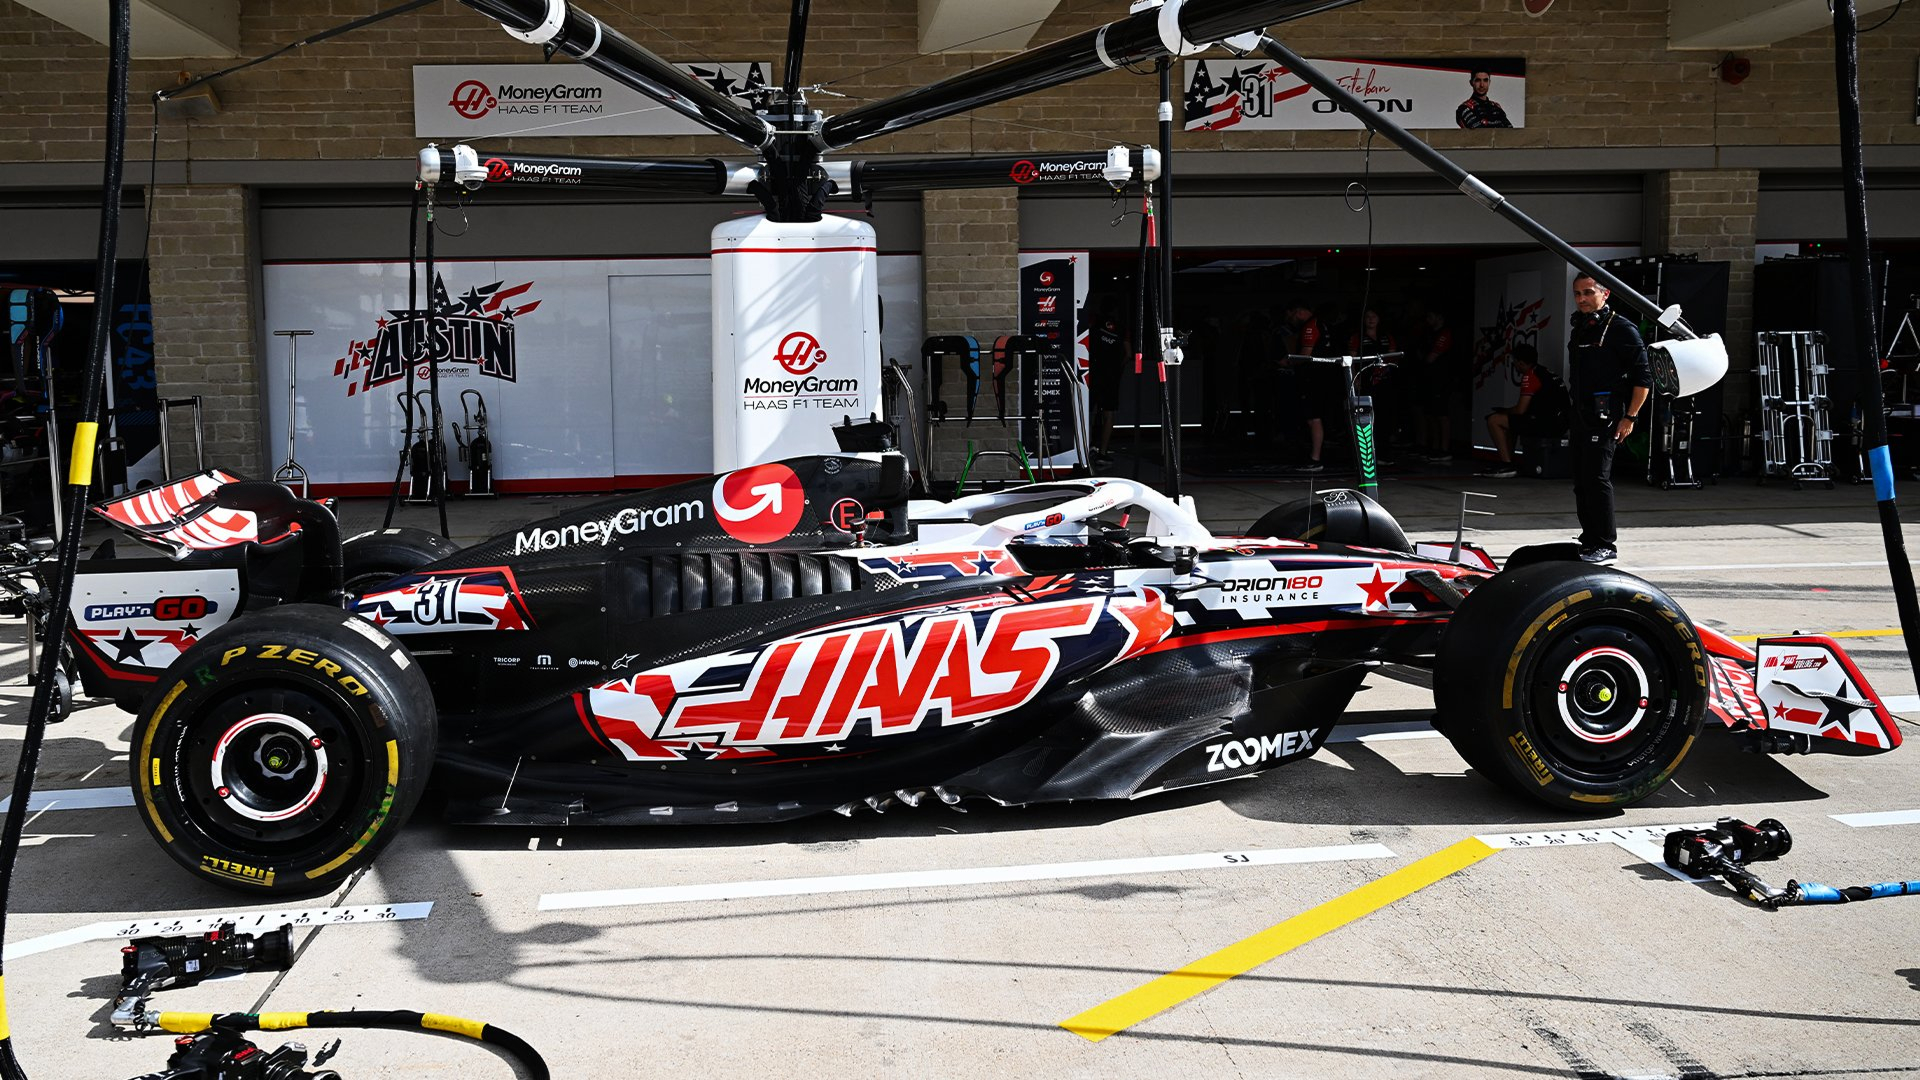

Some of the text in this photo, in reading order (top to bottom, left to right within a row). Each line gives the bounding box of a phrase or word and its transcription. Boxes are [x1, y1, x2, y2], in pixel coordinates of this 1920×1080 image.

[1336, 67, 1391, 97] Eteban
[498, 84, 602, 103] MoneyGram
[1241, 75, 1273, 118] 31
[498, 104, 603, 115] HAAS F1 TEAM
[1312, 98, 1413, 113] OON
[513, 162, 582, 177] MoneyGram
[1039, 161, 1107, 174] MoneyGram
[554, 177, 581, 185] TEAM
[366, 315, 517, 384] AUSTIN
[437, 366, 470, 374] oneyGram
[743, 376, 858, 397] MoneyGram
[743, 397, 859, 411] HAAS F1 TEAM
[515, 499, 704, 556] MoneyGram
[1046, 514, 1063, 527] GO
[1221, 575, 1323, 593] ORION180
[413, 577, 466, 627] 31
[1222, 591, 1319, 604] INSURANCE
[91, 597, 207, 620] PLAY'n GO
[1630, 592, 1707, 688] P ZERO
[220, 644, 369, 699] P ZERO
[656, 596, 1098, 748] HAAS
[1653, 714, 1674, 745] WHEELS
[1205, 727, 1320, 772] ZOOMEX
[1508, 730, 1555, 787] PIRELLI
[1512, 839, 1530, 847] 30
[1581, 836, 1598, 844] 10
[1223, 854, 1250, 864] SJ
[116, 927, 140, 936] 30
[160, 924, 183, 933] 20
[293, 917, 311, 925] 10
[333, 914, 355, 922] 20
[374, 911, 397, 920] 30
